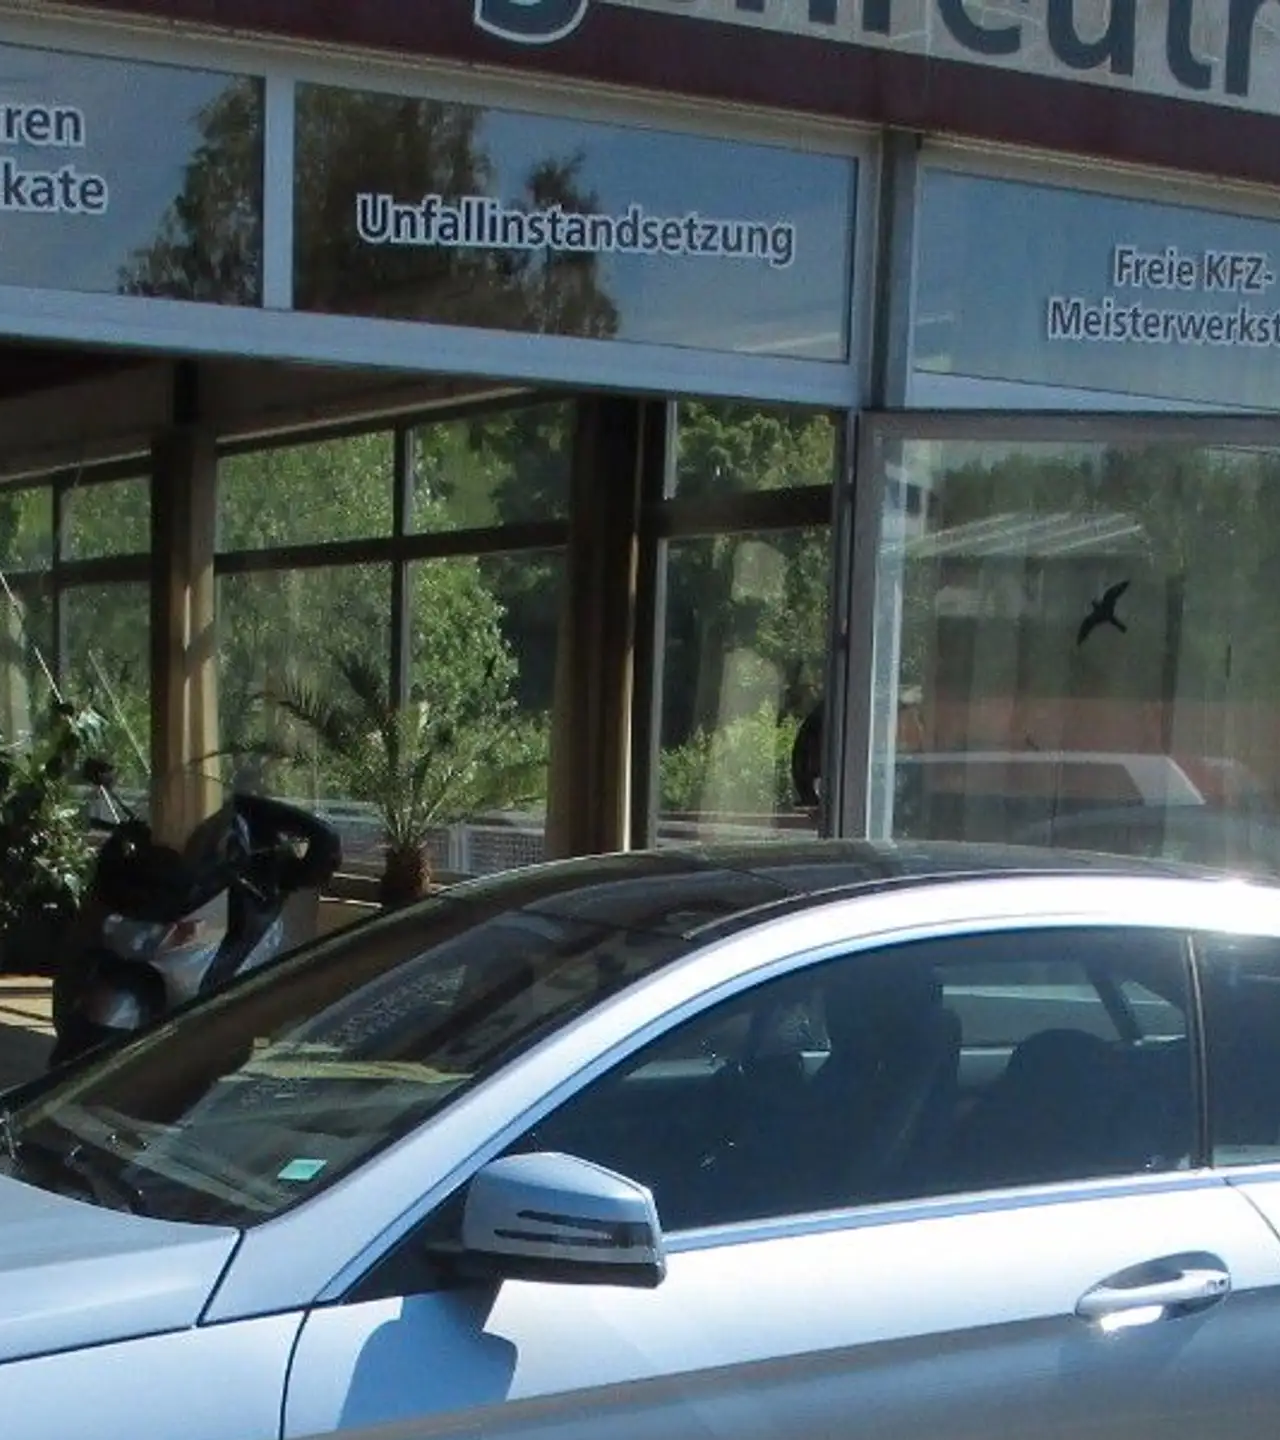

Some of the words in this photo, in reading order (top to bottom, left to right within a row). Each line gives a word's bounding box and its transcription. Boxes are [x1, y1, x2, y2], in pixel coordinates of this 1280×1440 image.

[357, 193, 796, 268] Unfallinstandsetzung
[1115, 246, 1194, 288] Freie
[1205, 251, 1274, 293] KFZ-
